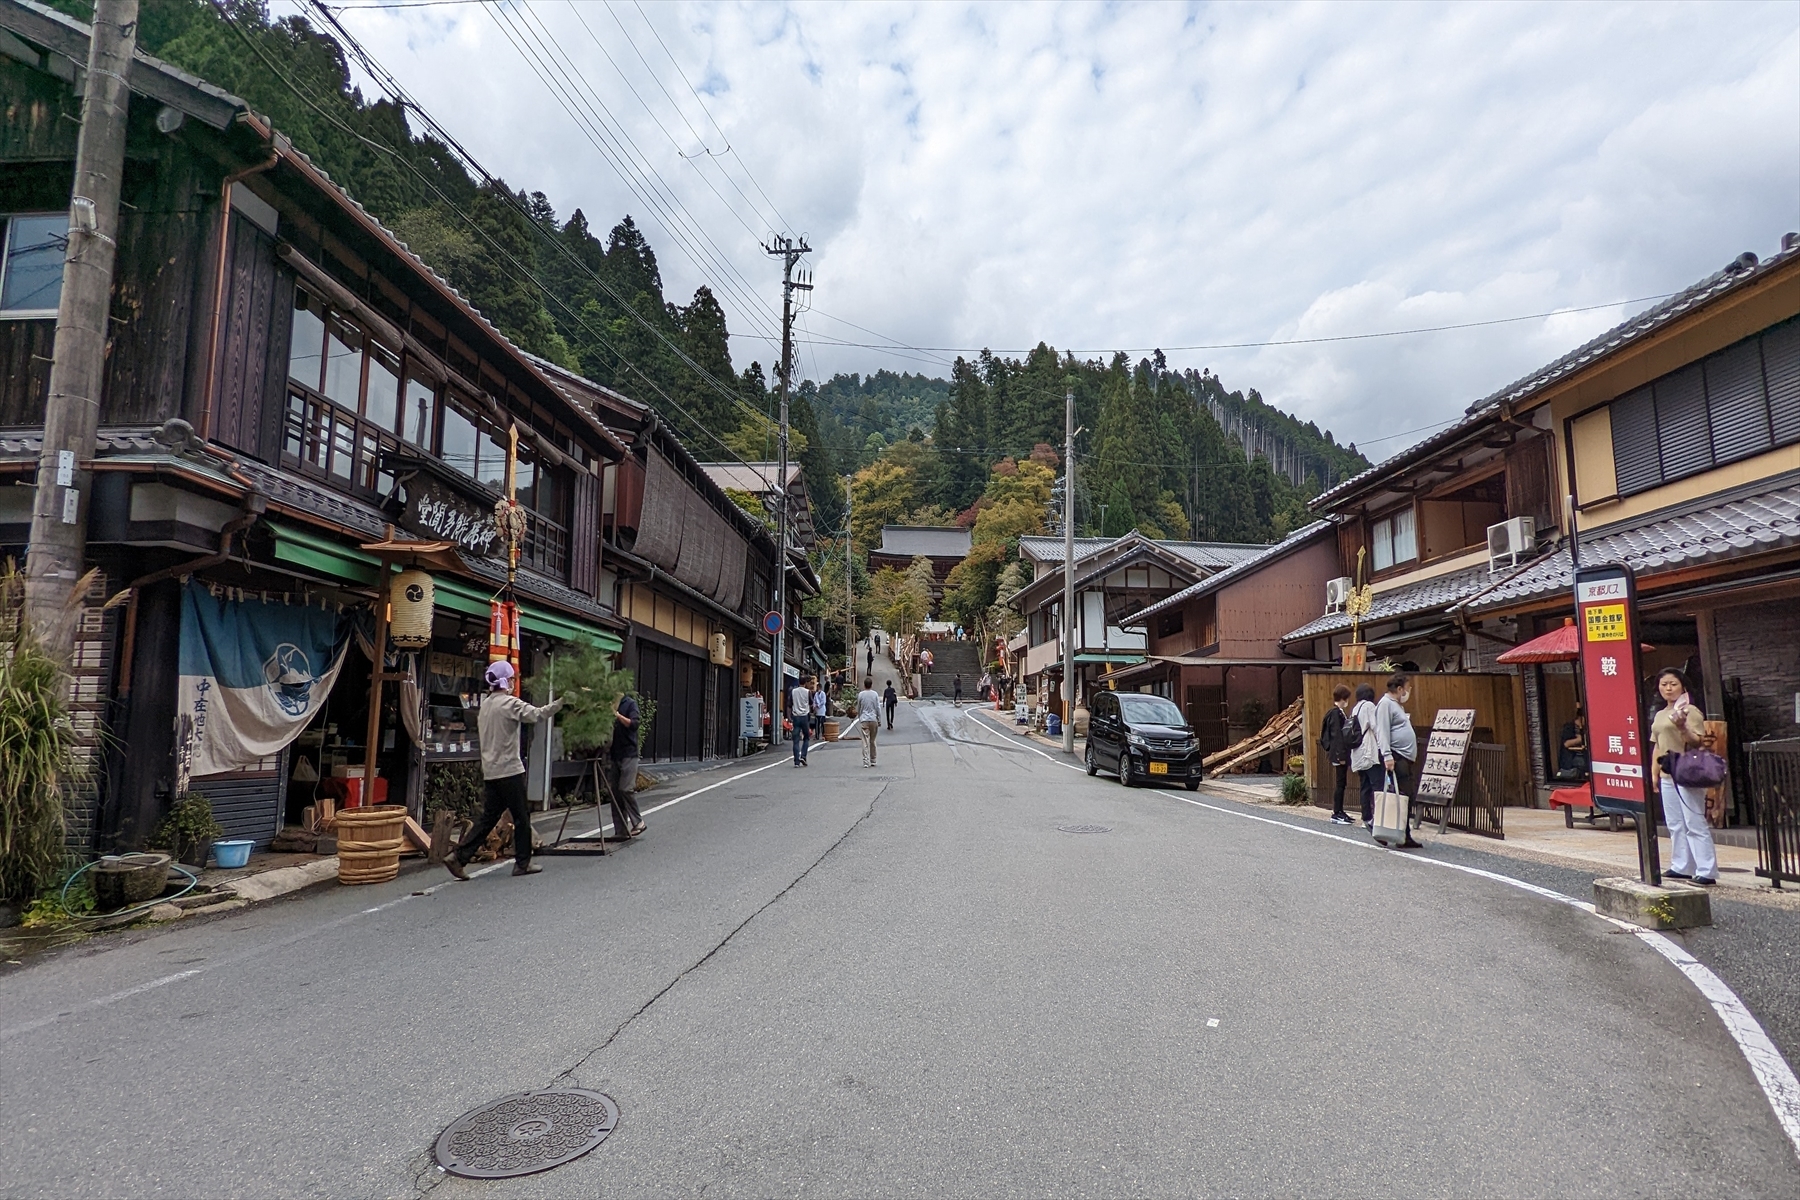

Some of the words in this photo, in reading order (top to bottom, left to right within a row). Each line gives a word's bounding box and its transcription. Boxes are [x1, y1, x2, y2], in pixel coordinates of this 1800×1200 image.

[1588, 584, 1619, 597] 京都バス
[1588, 614, 1622, 624] 国際会館駅
[1601, 657, 1623, 755] 鞍馬
[1627, 715, 1638, 756] 十王橋
[1606, 778, 1634, 789] KURAMA
